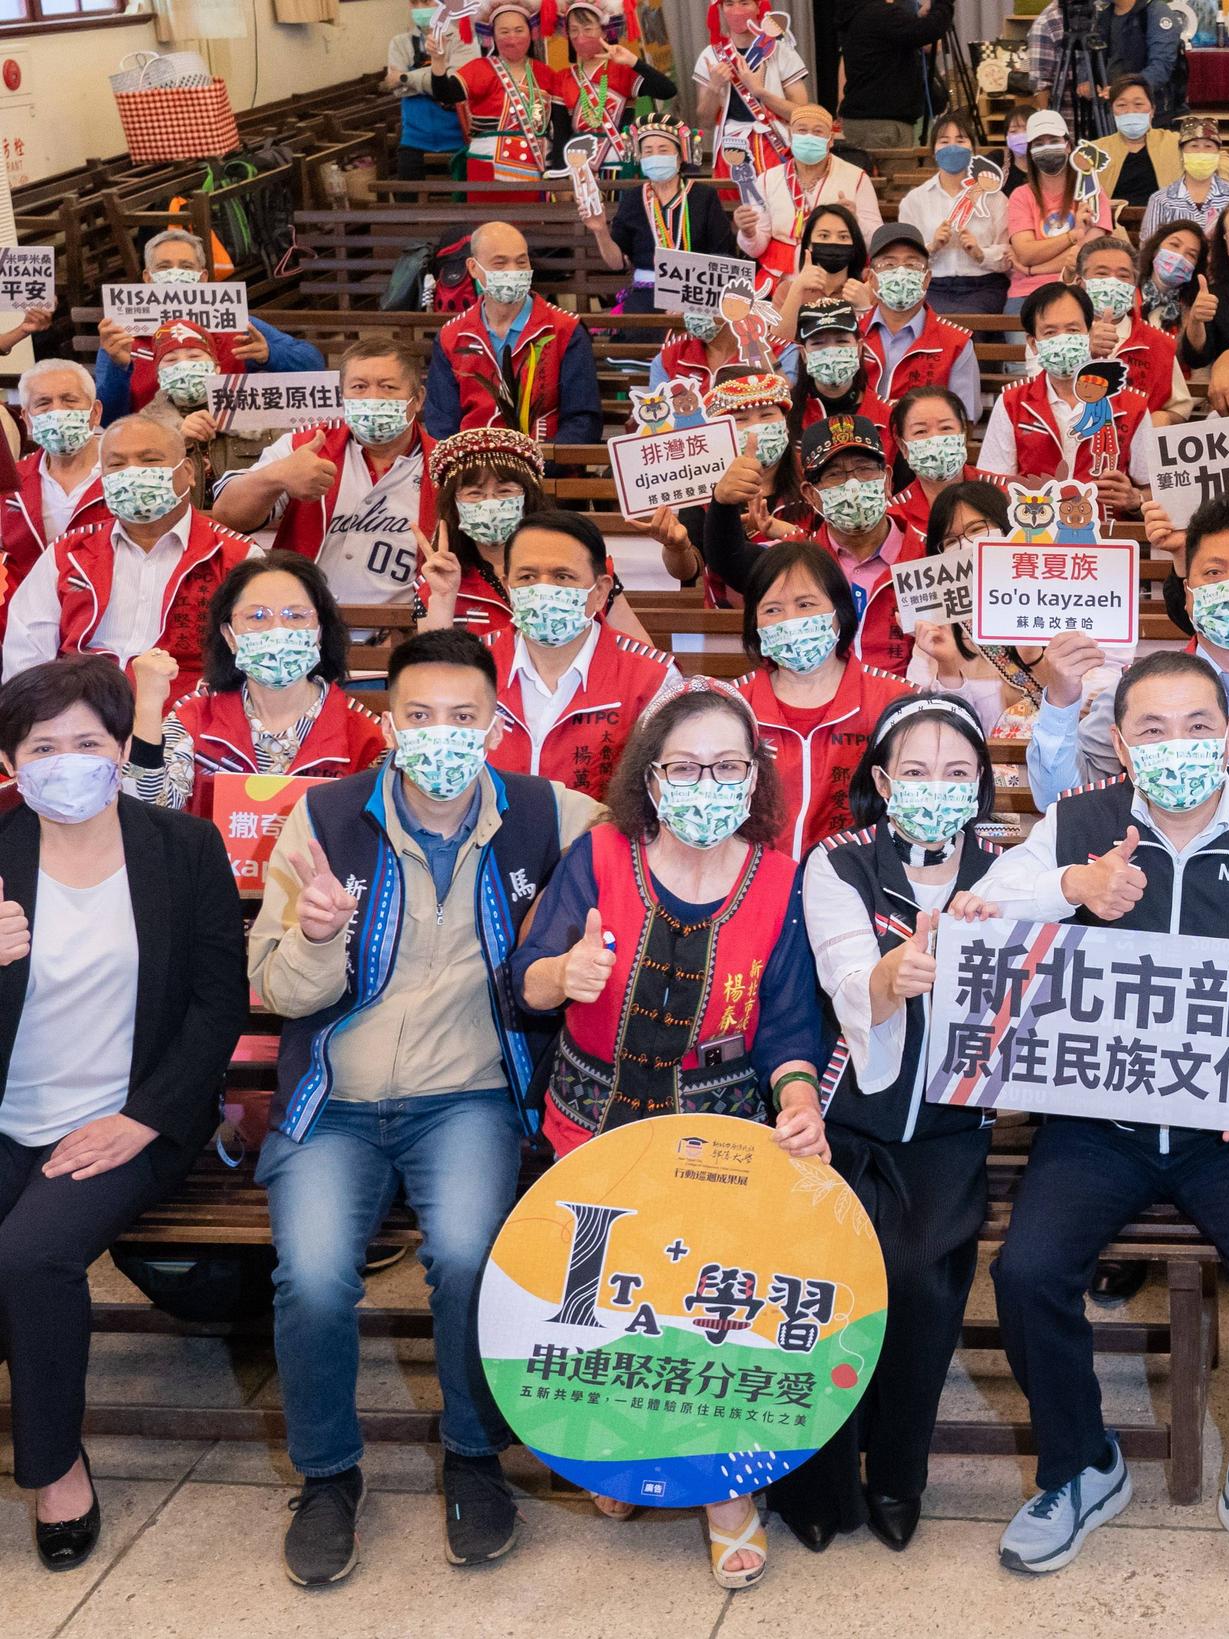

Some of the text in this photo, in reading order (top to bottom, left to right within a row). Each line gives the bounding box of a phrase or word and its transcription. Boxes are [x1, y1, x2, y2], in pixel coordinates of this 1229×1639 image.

[1, 281, 47, 300] 平安
[109, 287, 242, 306] KISAMULJAI
[641, 434, 709, 466] 排灣族
[635, 458, 726, 490] djavadjavai
[367, 540, 415, 582] 05
[1012, 552, 1099, 581] 賽夏族
[988, 588, 1122, 610] So'o kayzaeh
[571, 711, 621, 727] NTPC
[509, 868, 537, 902] 馬
[684, 1263, 836, 1353] 學習
[526, 1343, 818, 1410] 串連聚落分享愛
[643, 1482, 663, 1495] 廣告
